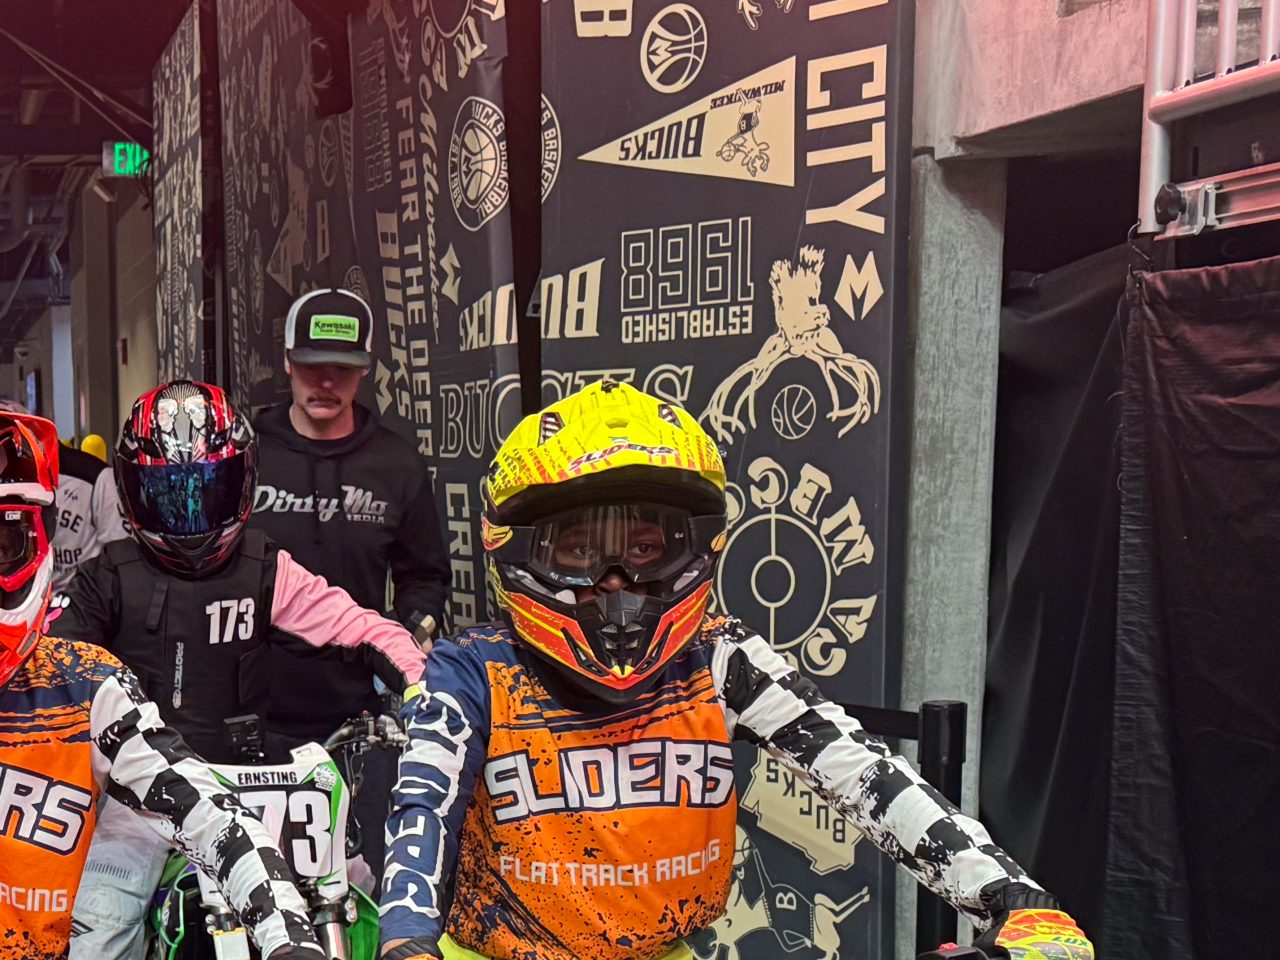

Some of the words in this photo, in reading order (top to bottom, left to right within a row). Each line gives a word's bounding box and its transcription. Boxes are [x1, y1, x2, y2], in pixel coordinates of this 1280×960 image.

[396, 96, 420, 223] FEAR
[618, 111, 709, 162] BUCKS
[806, 44, 887, 235] CITY
[404, 233, 427, 326] THE
[621, 216, 755, 313] 1968
[622, 305, 753, 344] ESTABLISHED
[410, 343, 434, 457] DEER
[253, 485, 339, 522] Dirty
[341, 485, 389, 515] Mo
[446, 482, 478, 626] CREA
[205, 597, 256, 645] 173
[237, 771, 298, 785] ERNSTING
[484, 738, 735, 824] SLIDERS
[766, 756, 847, 844] BUCKS
[500, 856, 559, 886] FLAT
[565, 862, 649, 888] TRACK
